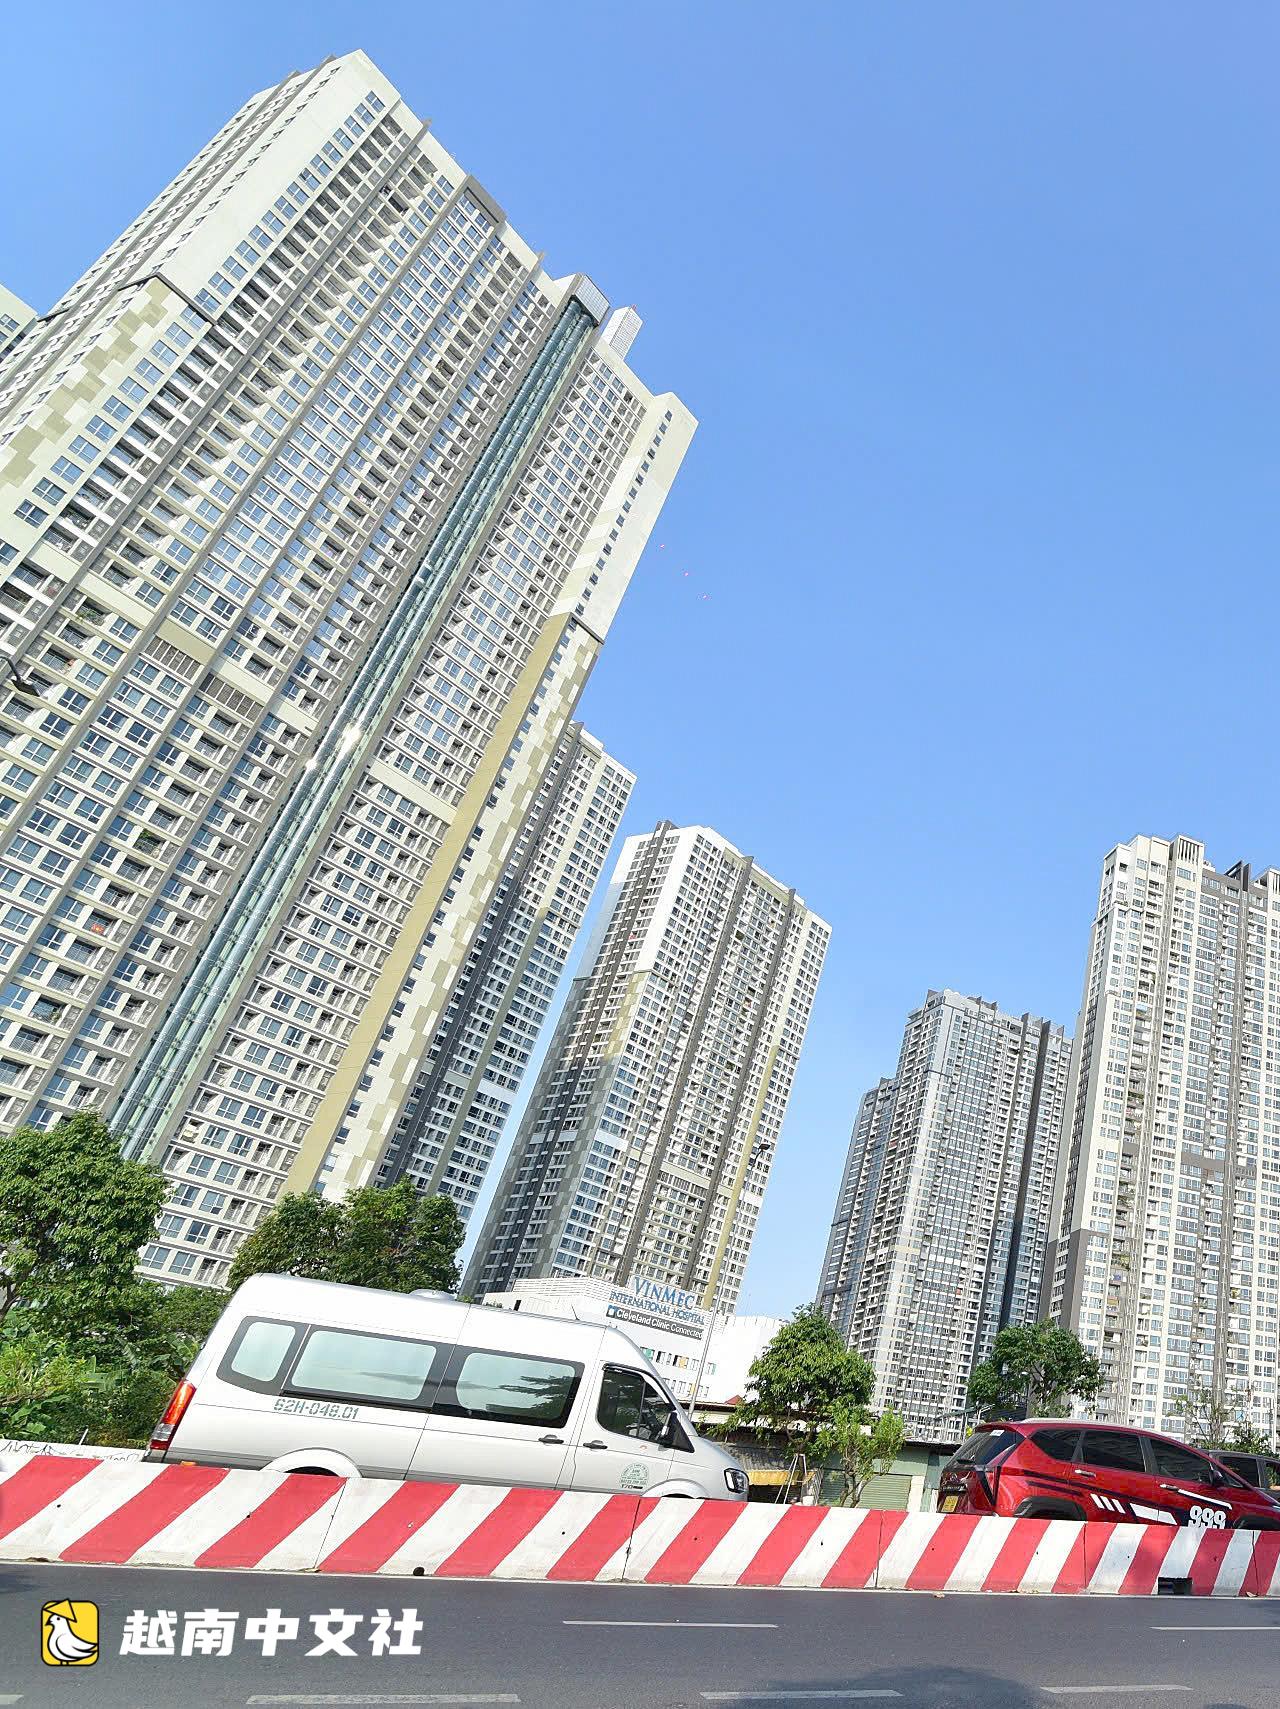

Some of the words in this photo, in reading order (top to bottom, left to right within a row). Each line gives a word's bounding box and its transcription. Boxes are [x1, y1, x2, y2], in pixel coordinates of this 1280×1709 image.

[609, 1291, 670, 1314] INTERNATIONAL
[671, 1307, 705, 1324] HOSPITAL
[635, 1276, 695, 1310] VINMEC
[616, 1309, 651, 1325] Cleveland
[651, 1318, 670, 1330] Clinic
[670, 1323, 703, 1340] Connected
[1187, 1505, 1227, 1530] 999
